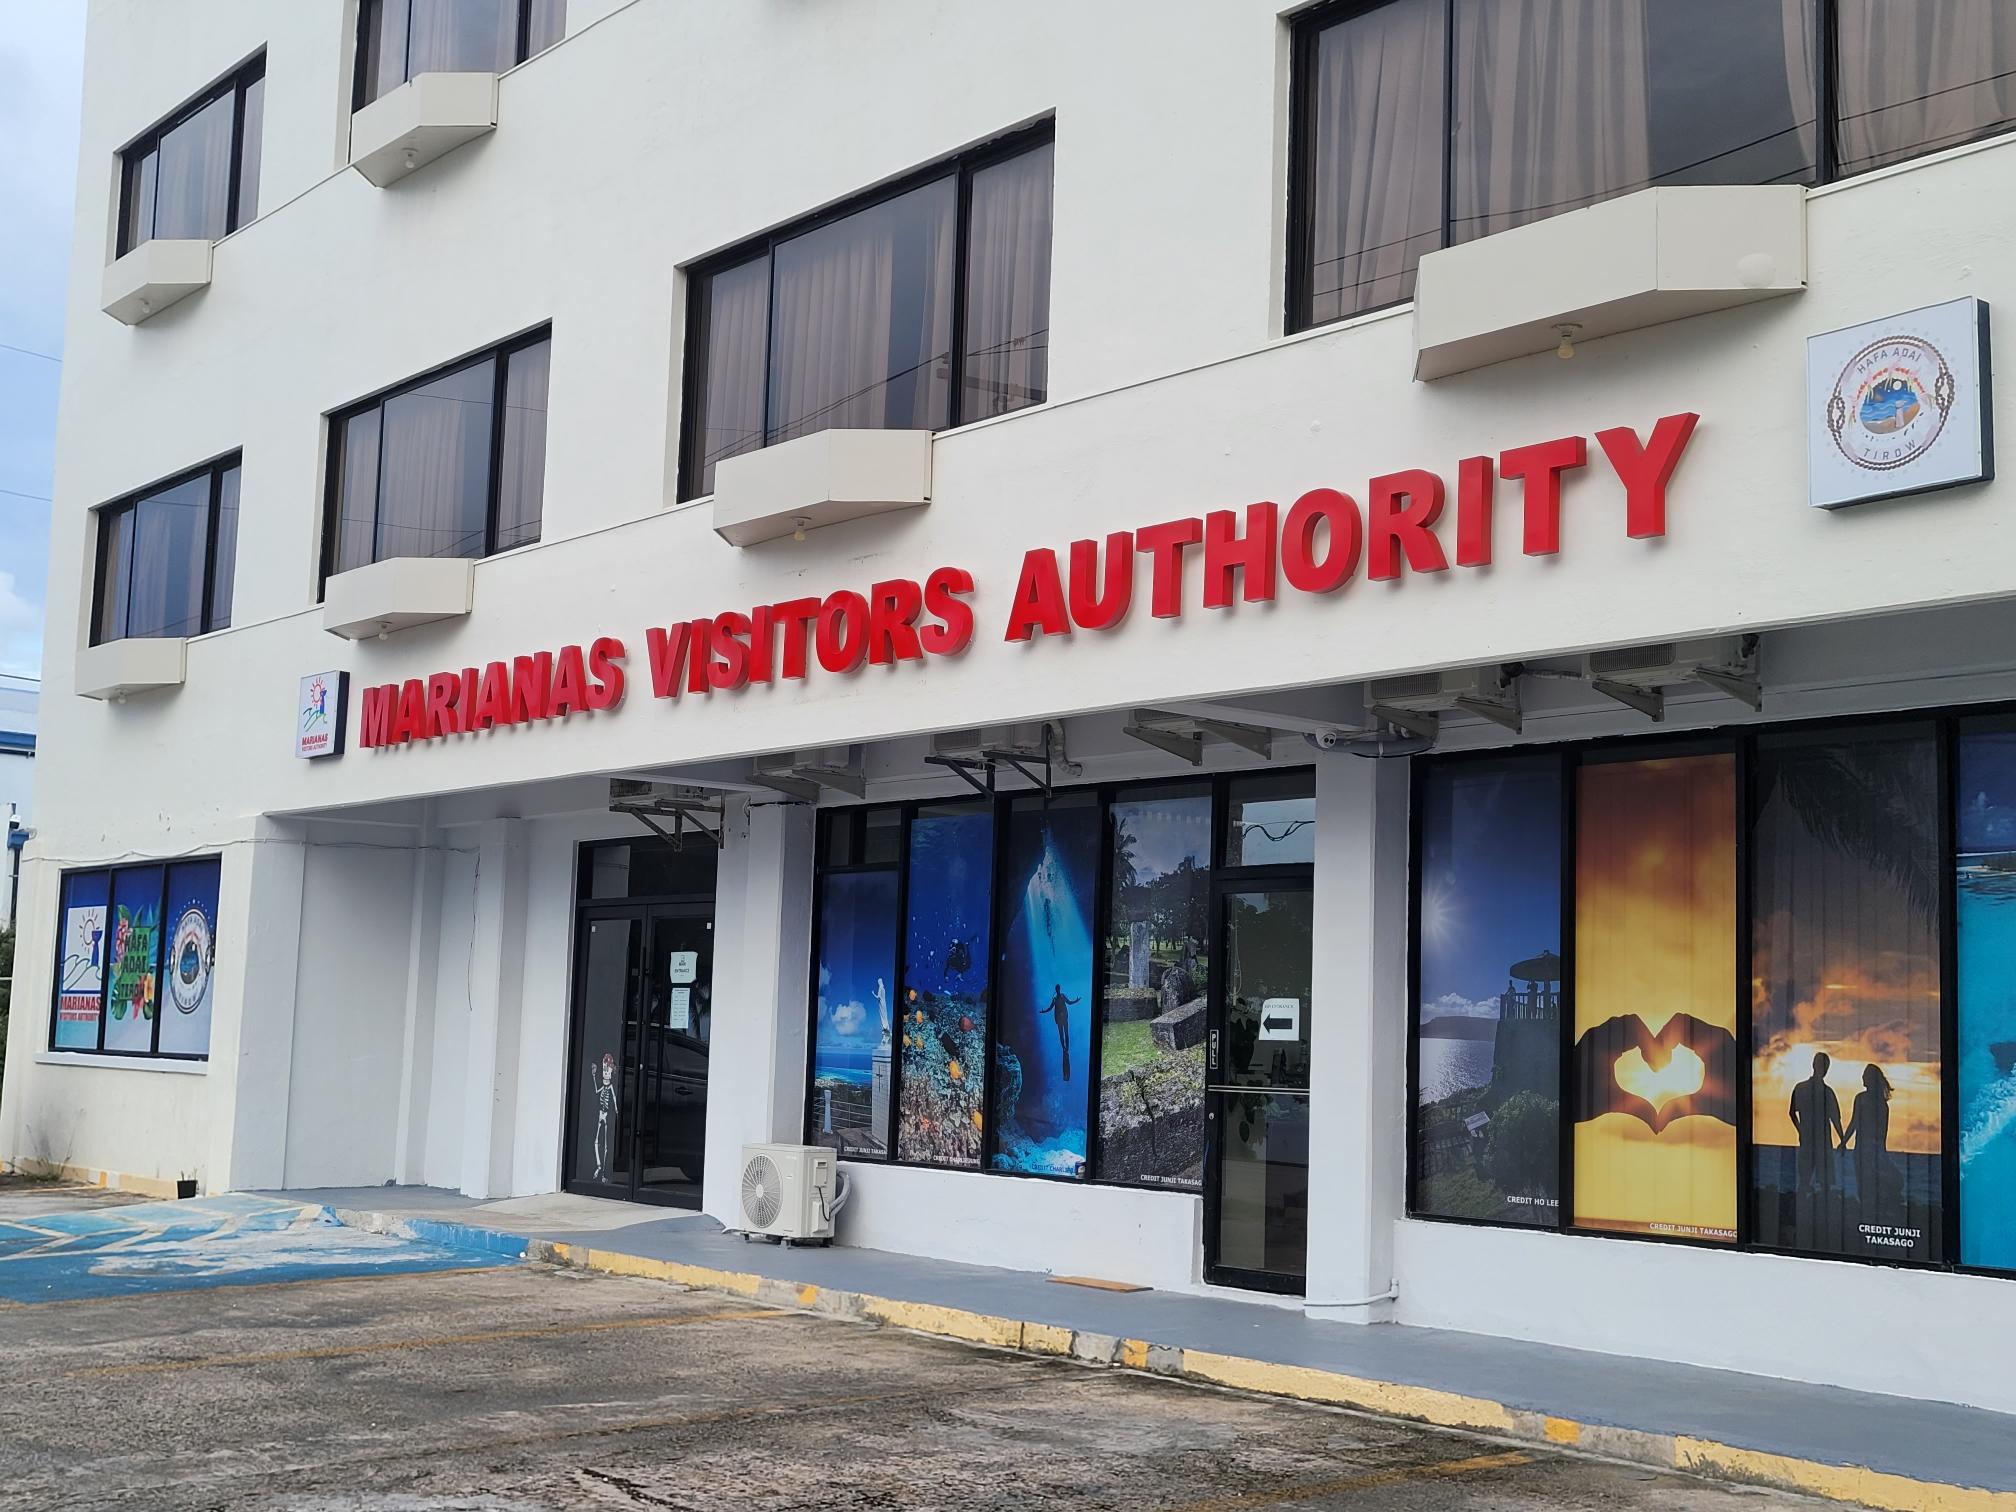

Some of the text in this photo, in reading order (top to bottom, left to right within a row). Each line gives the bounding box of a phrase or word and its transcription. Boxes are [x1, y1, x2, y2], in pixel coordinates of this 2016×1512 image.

[1857, 347, 1922, 374] HAFA ADAI
[1864, 439, 1915, 460] TIROW
[360, 412, 1700, 748] MARIANAS VISITORS AUTHORITY
[60, 996, 101, 1011] MARIANAS
[1140, 1174, 1160, 1182] CREDIT
[1161, 1176, 1177, 1184] JUNJI
[1507, 1195, 1559, 1207] CREDIT HO LEE
[1649, 1222, 1675, 1231] CREDIT
[1677, 1225, 1698, 1234] JUNJI
[1858, 1224, 1920, 1238] CREDIT JUNJI
[1865, 1235, 1914, 1248] TAKASAGO
